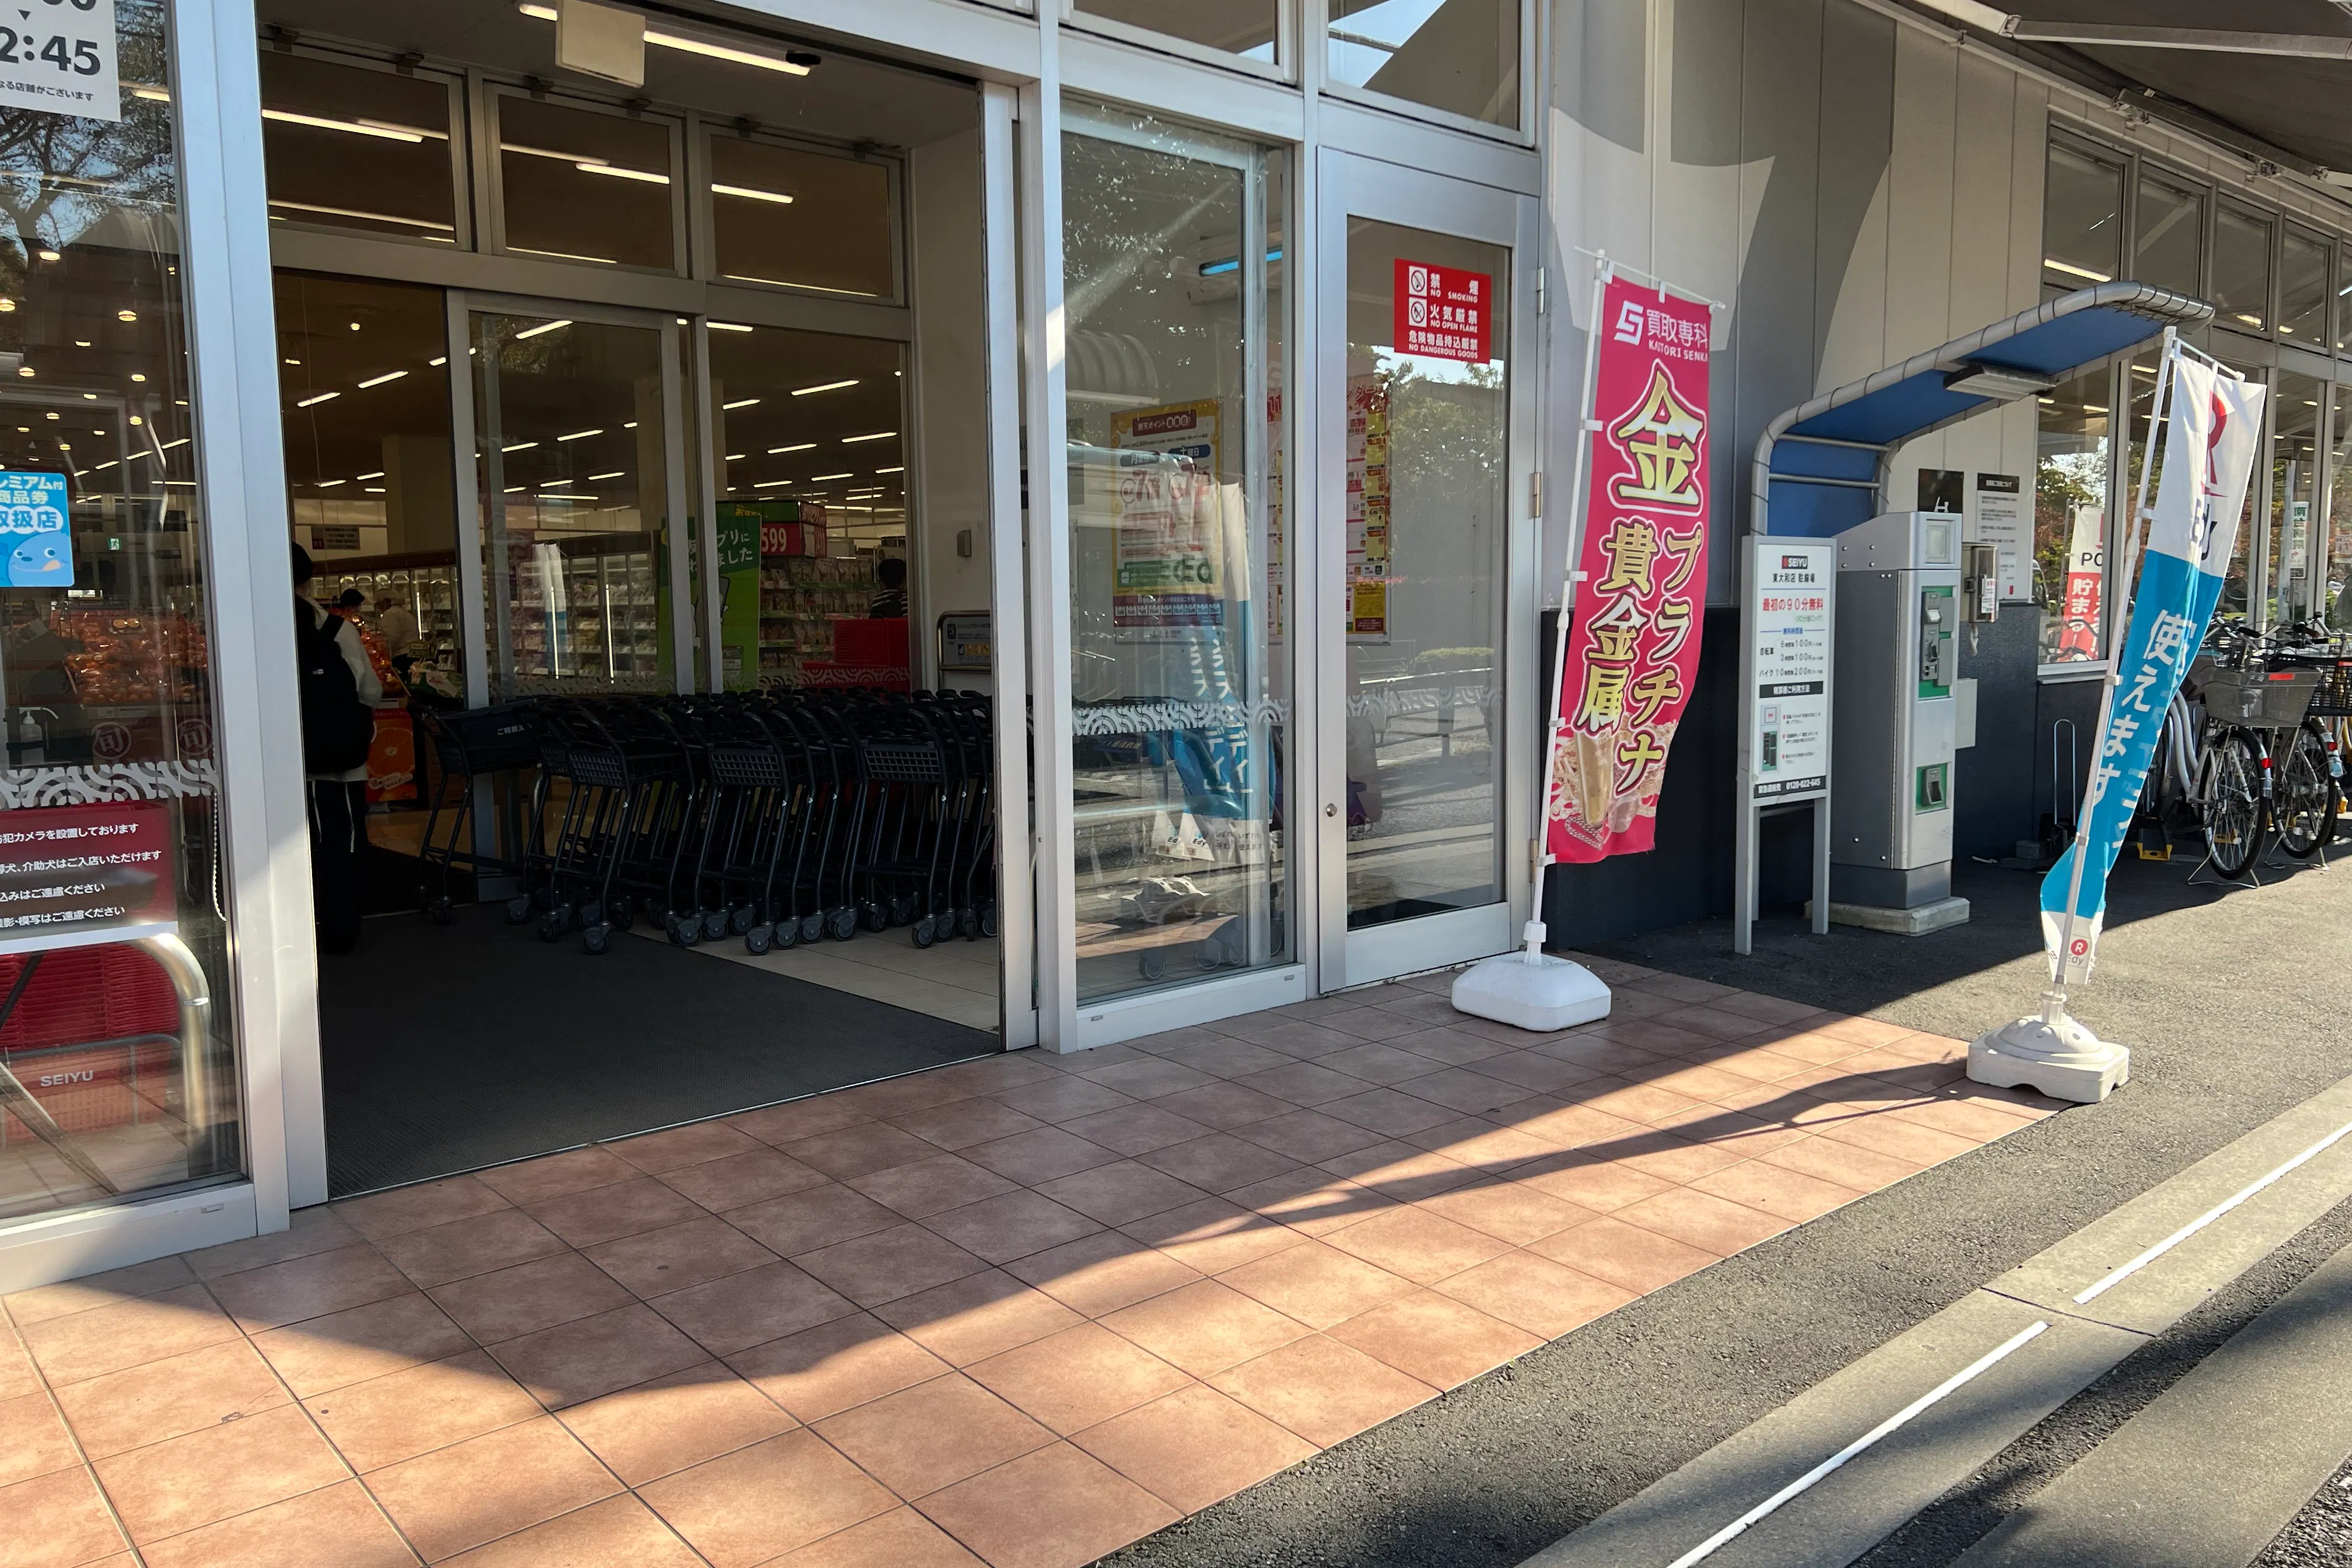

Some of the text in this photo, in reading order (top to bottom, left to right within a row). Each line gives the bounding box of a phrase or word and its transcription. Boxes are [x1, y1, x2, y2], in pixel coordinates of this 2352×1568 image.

[1430, 272, 1441, 289] 禁
[1430, 289, 1478, 303] NO SMOKING
[1430, 303, 1478, 326] 火気厳禁
[1430, 320, 1478, 333] NO OPEN FLAME
[1646, 309, 1708, 349] 買取専科
[1409, 329, 1479, 351] 危険物品持込厳禁
[1648, 340, 1682, 358] KAITORI
[1409, 343, 1478, 359] NO DANGEROUS GOODS
[1614, 365, 1705, 511] 金
[1787, 558, 1808, 568] SEIYU
[1576, 521, 1659, 734] 貴金属
[1615, 523, 1703, 795] プラチナ
[2094, 608, 2188, 807] 使えます
[0, 823, 139, 844] 犯カメラを設置しております
[40, 1070, 93, 1087] SEIYU
